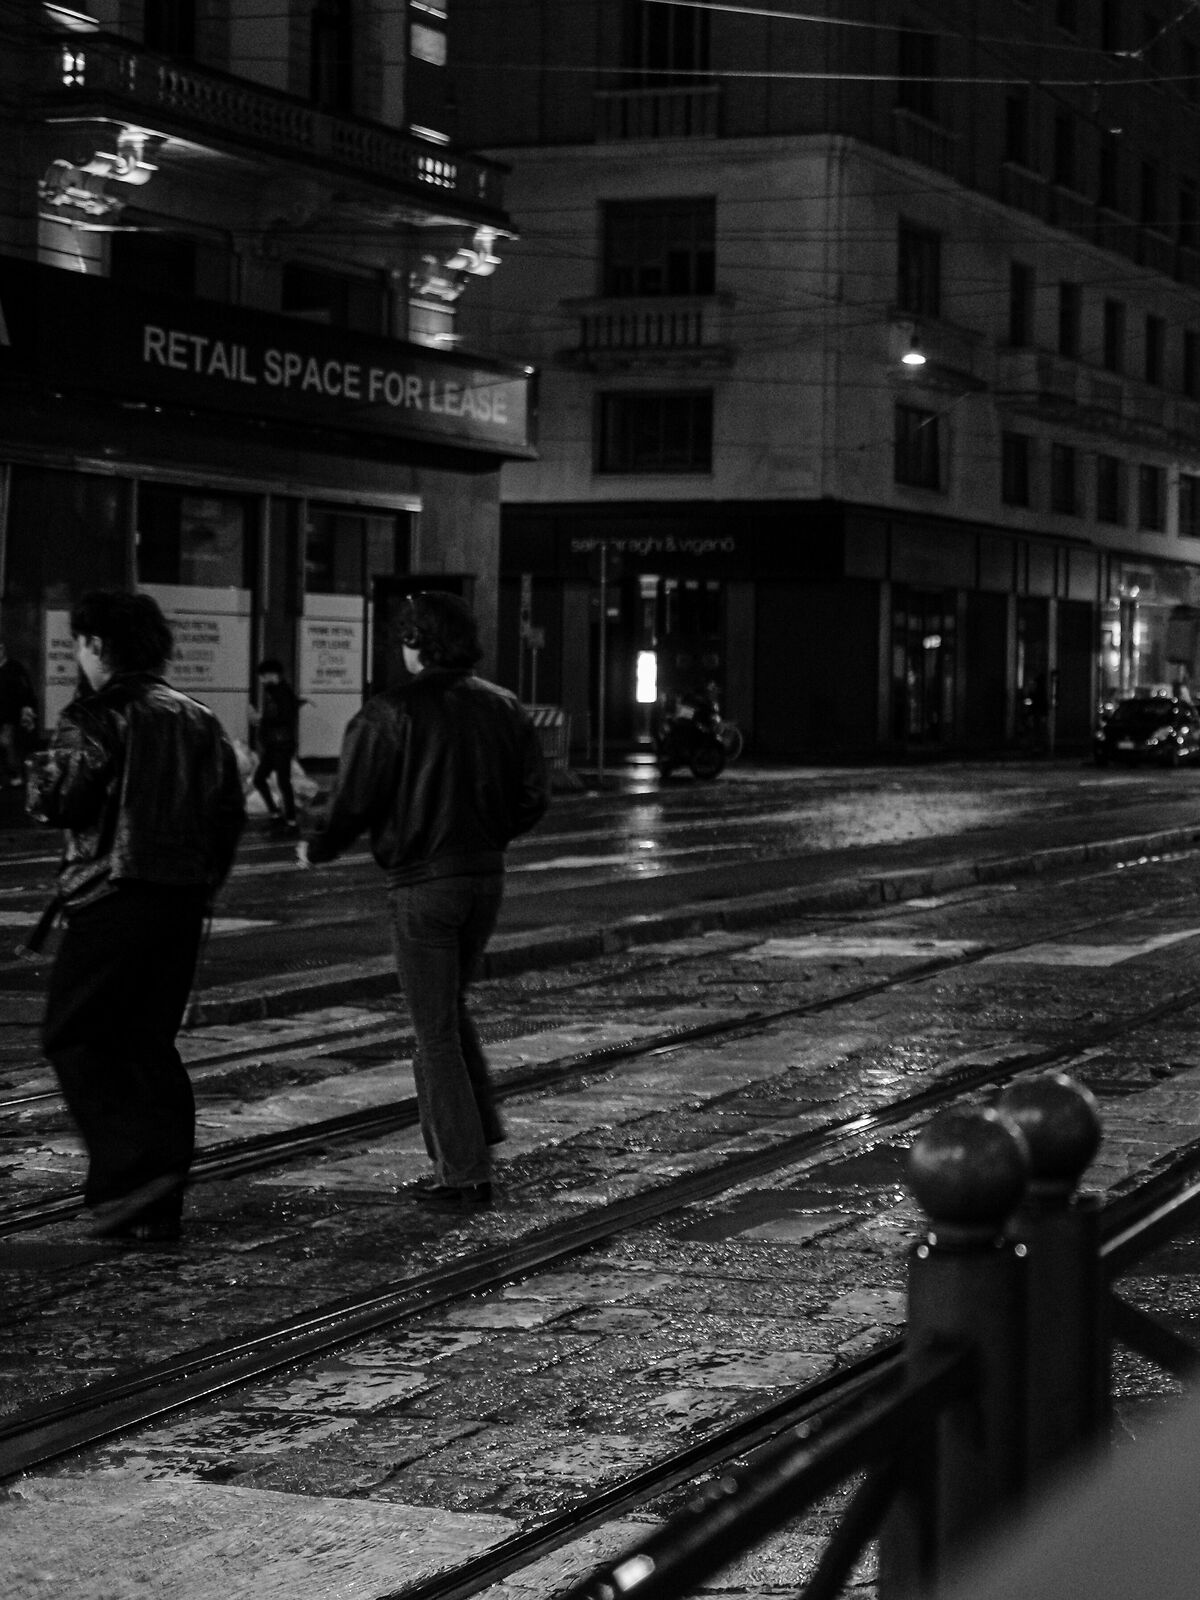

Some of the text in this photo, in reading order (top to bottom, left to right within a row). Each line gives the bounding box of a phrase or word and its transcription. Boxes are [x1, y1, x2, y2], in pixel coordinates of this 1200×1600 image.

[143, 324, 508, 425] RETAIL SPACE FOR LEASE
